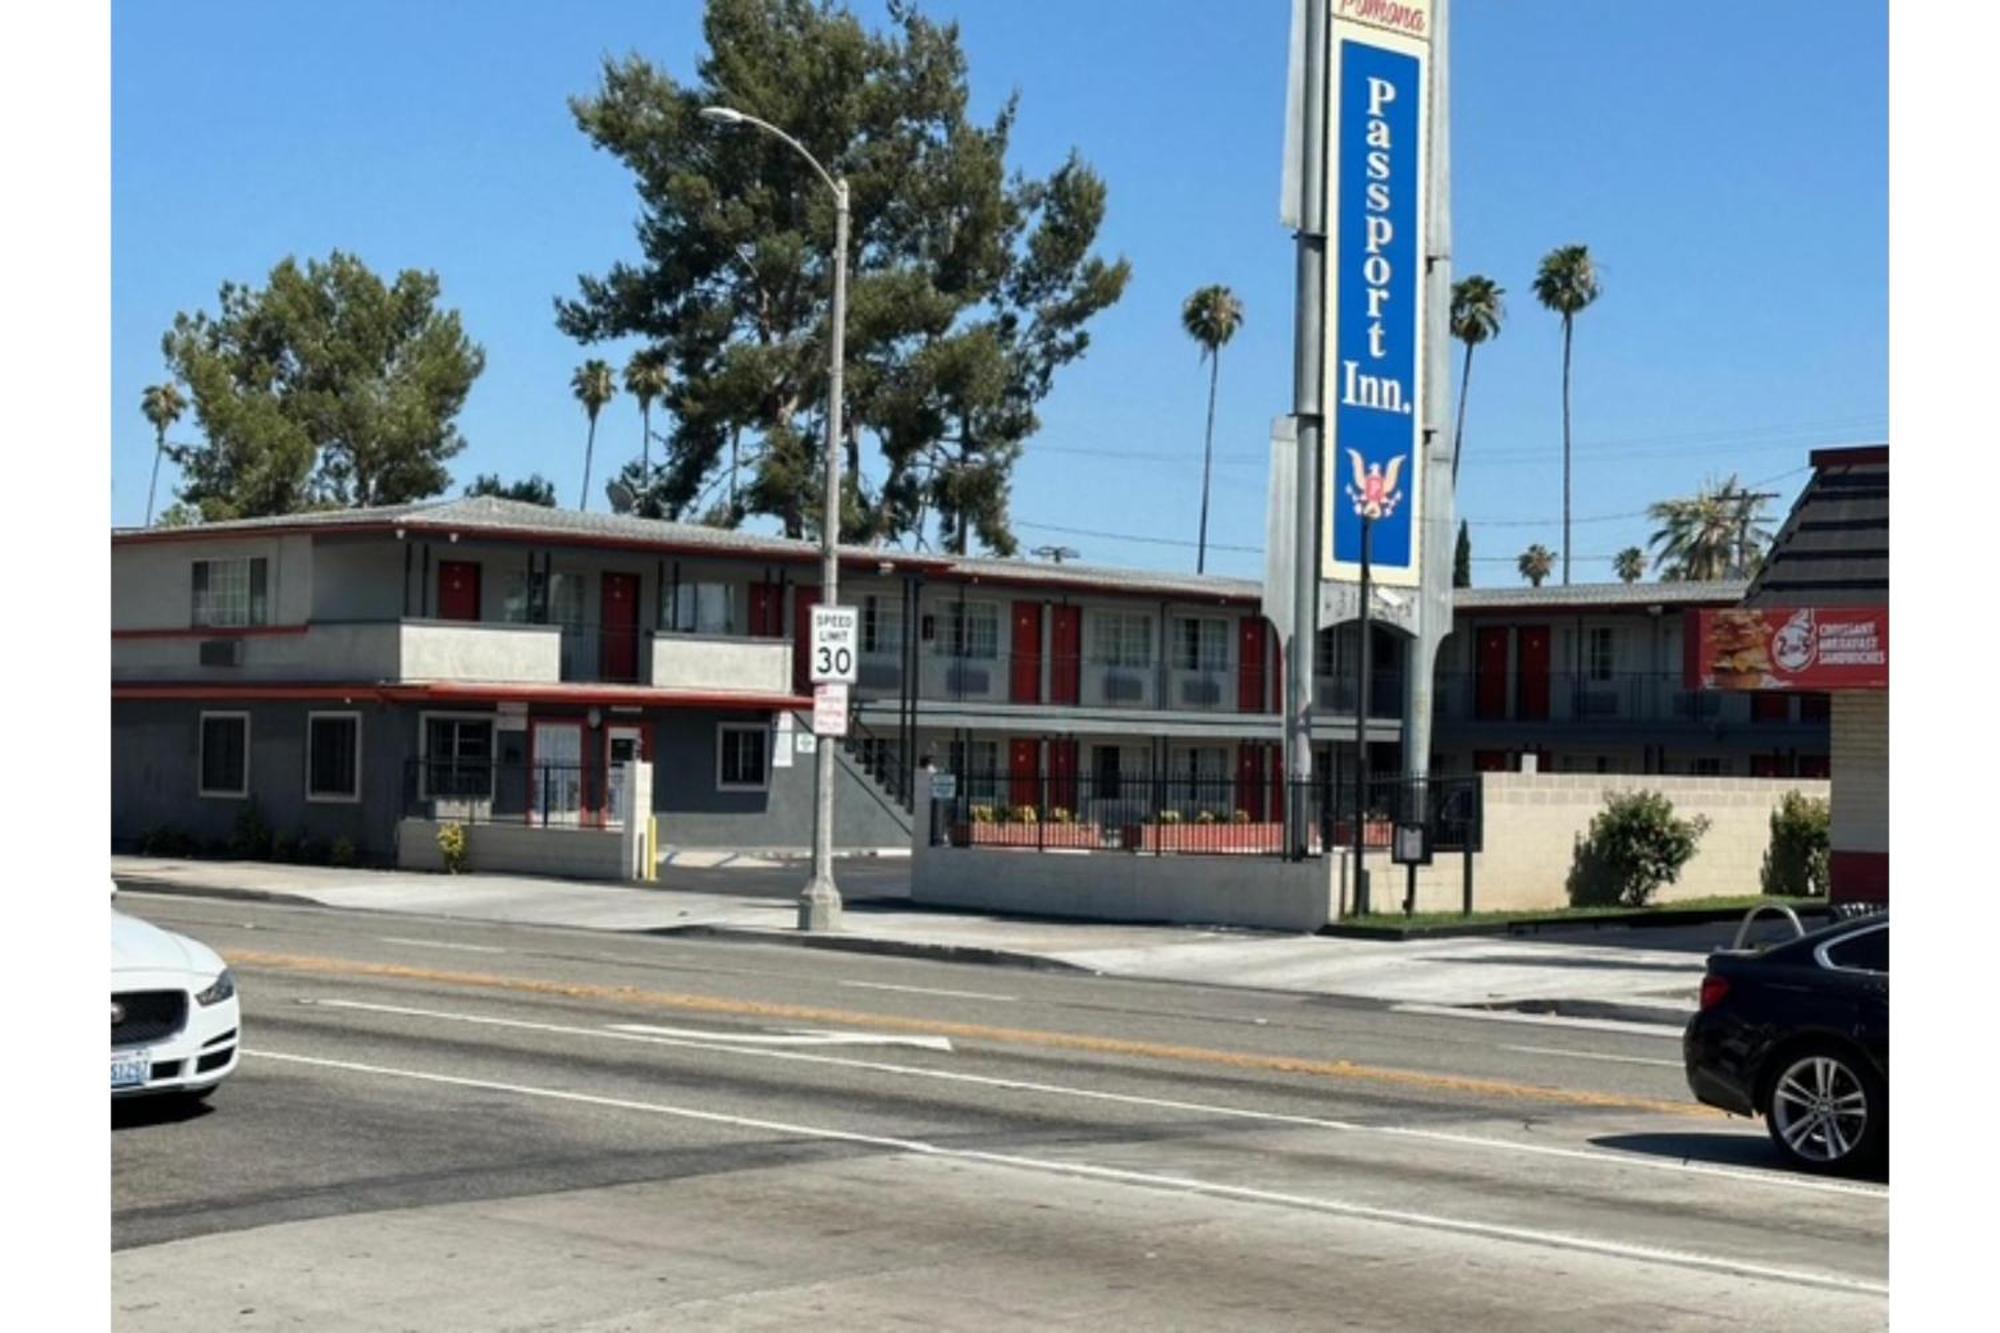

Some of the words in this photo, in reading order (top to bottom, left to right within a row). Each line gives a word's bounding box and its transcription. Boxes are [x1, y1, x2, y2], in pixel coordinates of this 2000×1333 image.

[1363, 76, 1397, 359] Passport
[1342, 360, 1412, 414] Inn.
[816, 613, 853, 629] SPEED
[819, 630, 848, 643] LIMIT
[816, 647, 851, 674] 30
